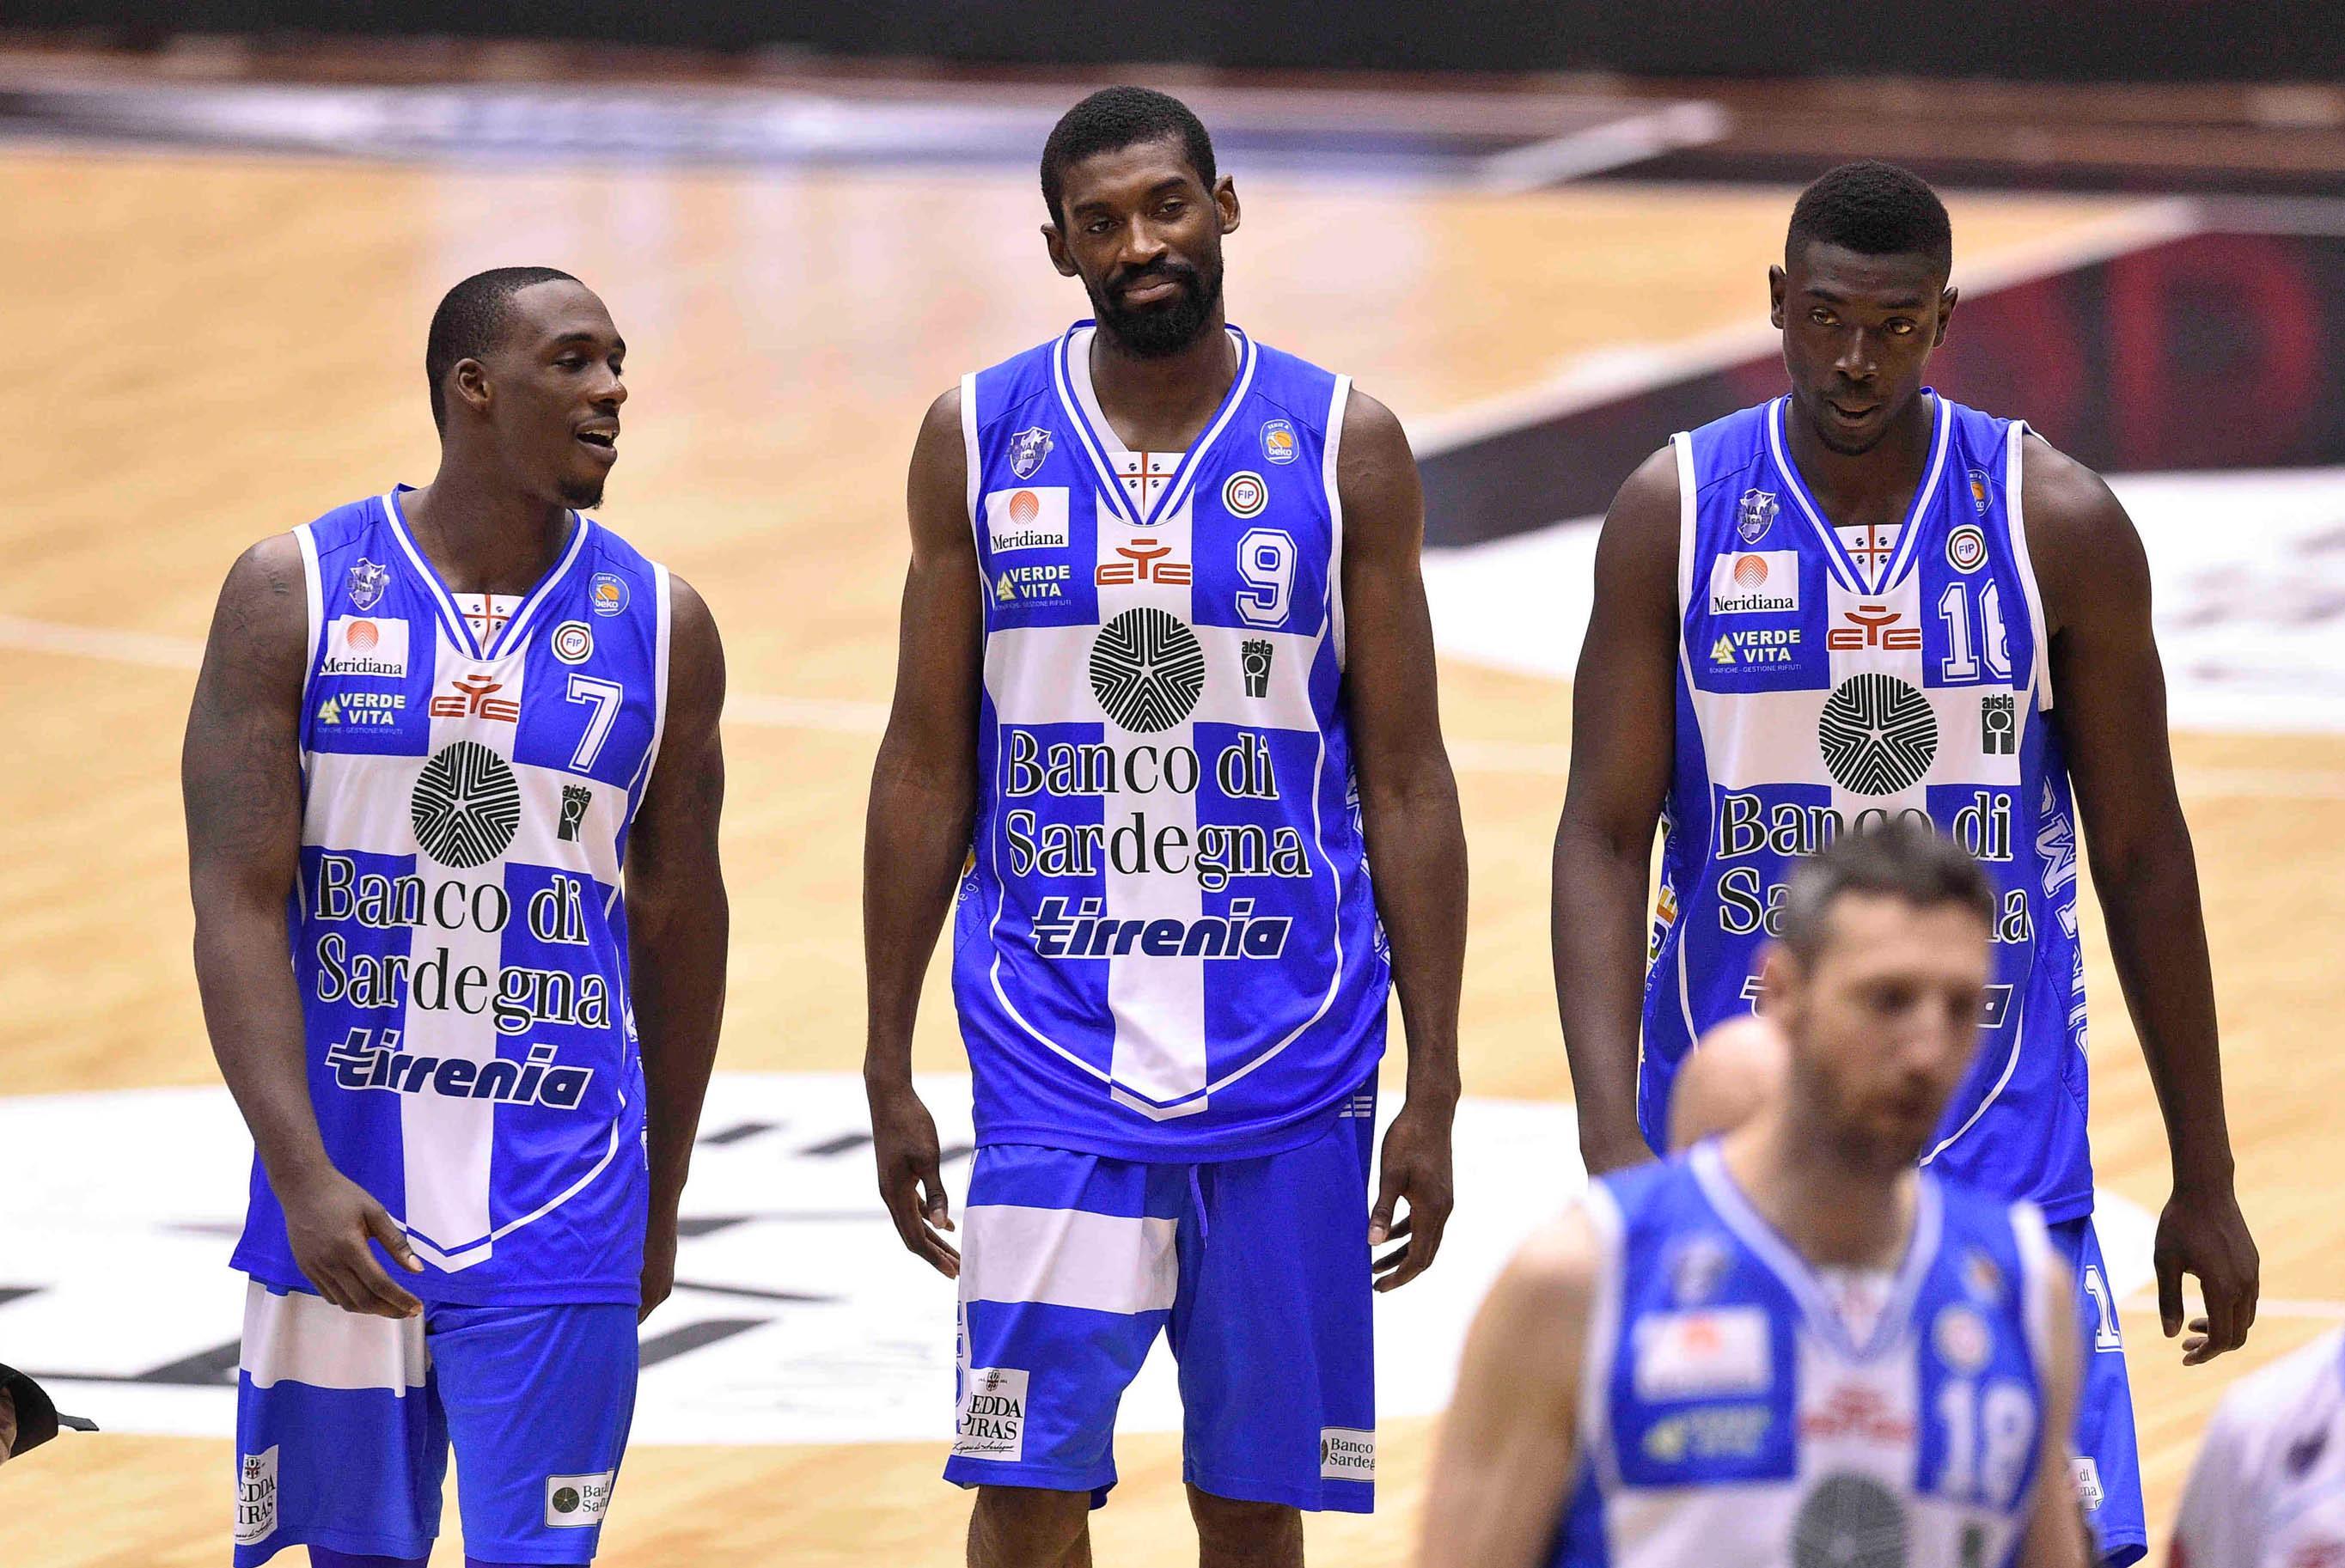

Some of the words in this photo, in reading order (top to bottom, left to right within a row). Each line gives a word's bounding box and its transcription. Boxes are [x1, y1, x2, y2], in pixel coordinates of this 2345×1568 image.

[1268, 445, 1292, 457] beko
[1237, 489, 1255, 500] FIP
[992, 530, 1065, 550] Meridiana
[1958, 543, 1975, 555] FIP
[1010, 565, 1071, 582] VERDE
[1235, 527, 1298, 629] 9
[1019, 583, 1062, 599] VITA
[595, 598, 619, 610] beko
[1713, 594, 1794, 613] Meridiana
[565, 637, 583, 648] FIP
[1732, 629, 1801, 644] VERDE
[1241, 638, 1273, 656] aisla
[1743, 647, 1792, 663] VITA
[321, 657, 403, 675] Meridiana
[1743, 665, 1777, 674] GESTIONE
[1777, 663, 1801, 673] RIFIUTI
[339, 692, 406, 710] VERDE
[1982, 693, 2015, 710] aisla
[348, 711, 395, 726] VITA
[565, 673, 624, 773] 7
[1006, 729, 1201, 796] Banco
[1216, 731, 1279, 800] di
[562, 783, 593, 803] aisla
[1954, 790, 2013, 861] di
[1006, 808, 1313, 894] Sardegna
[315, 854, 511, 933] Banco
[527, 874, 589, 946] di
[1029, 895, 1293, 961] tirrenia
[315, 932, 612, 1034] Sardegna
[325, 1027, 595, 1110] tirrenia
[968, 1392, 1023, 1419] EDDA
[1331, 1437, 1373, 1454] Banco
[1329, 1452, 1375, 1471] Sardeg
